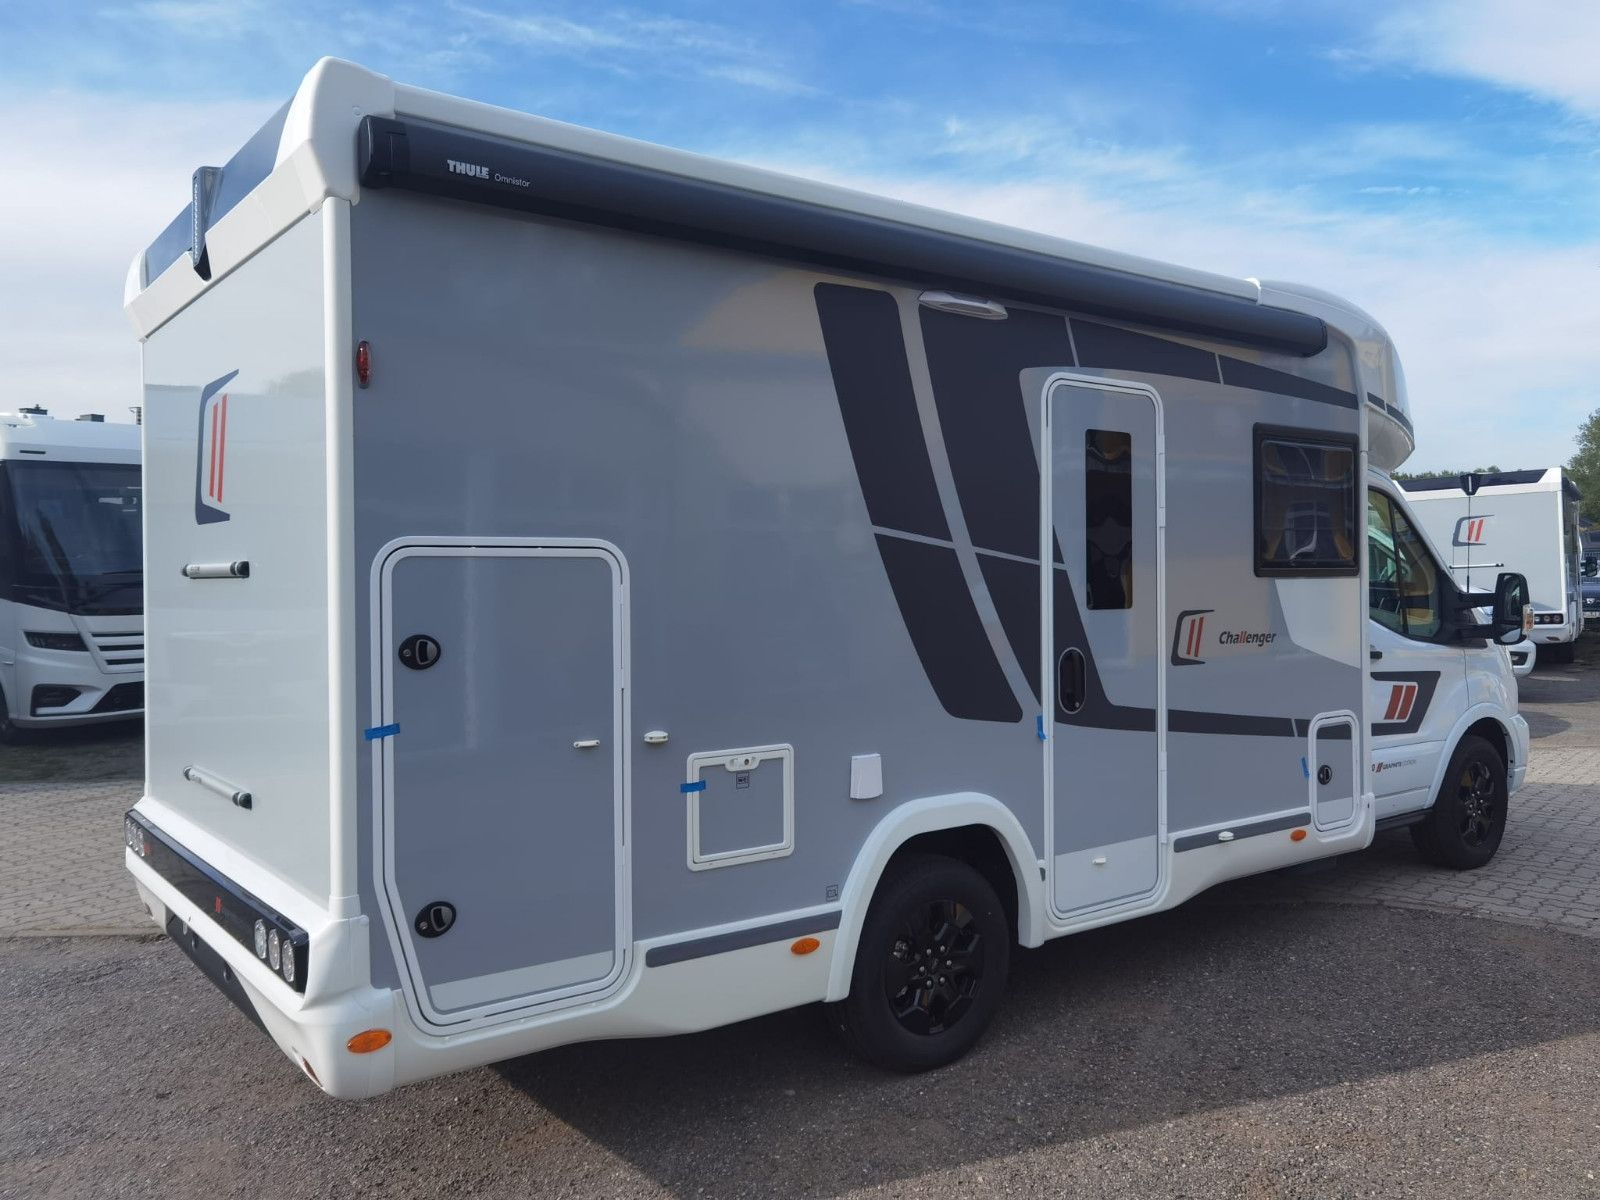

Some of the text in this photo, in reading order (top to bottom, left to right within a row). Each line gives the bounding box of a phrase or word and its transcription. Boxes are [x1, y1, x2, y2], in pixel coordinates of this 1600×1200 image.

[447, 159, 531, 187] THULE Omnistor
[1219, 630, 1277, 647] Challenger
